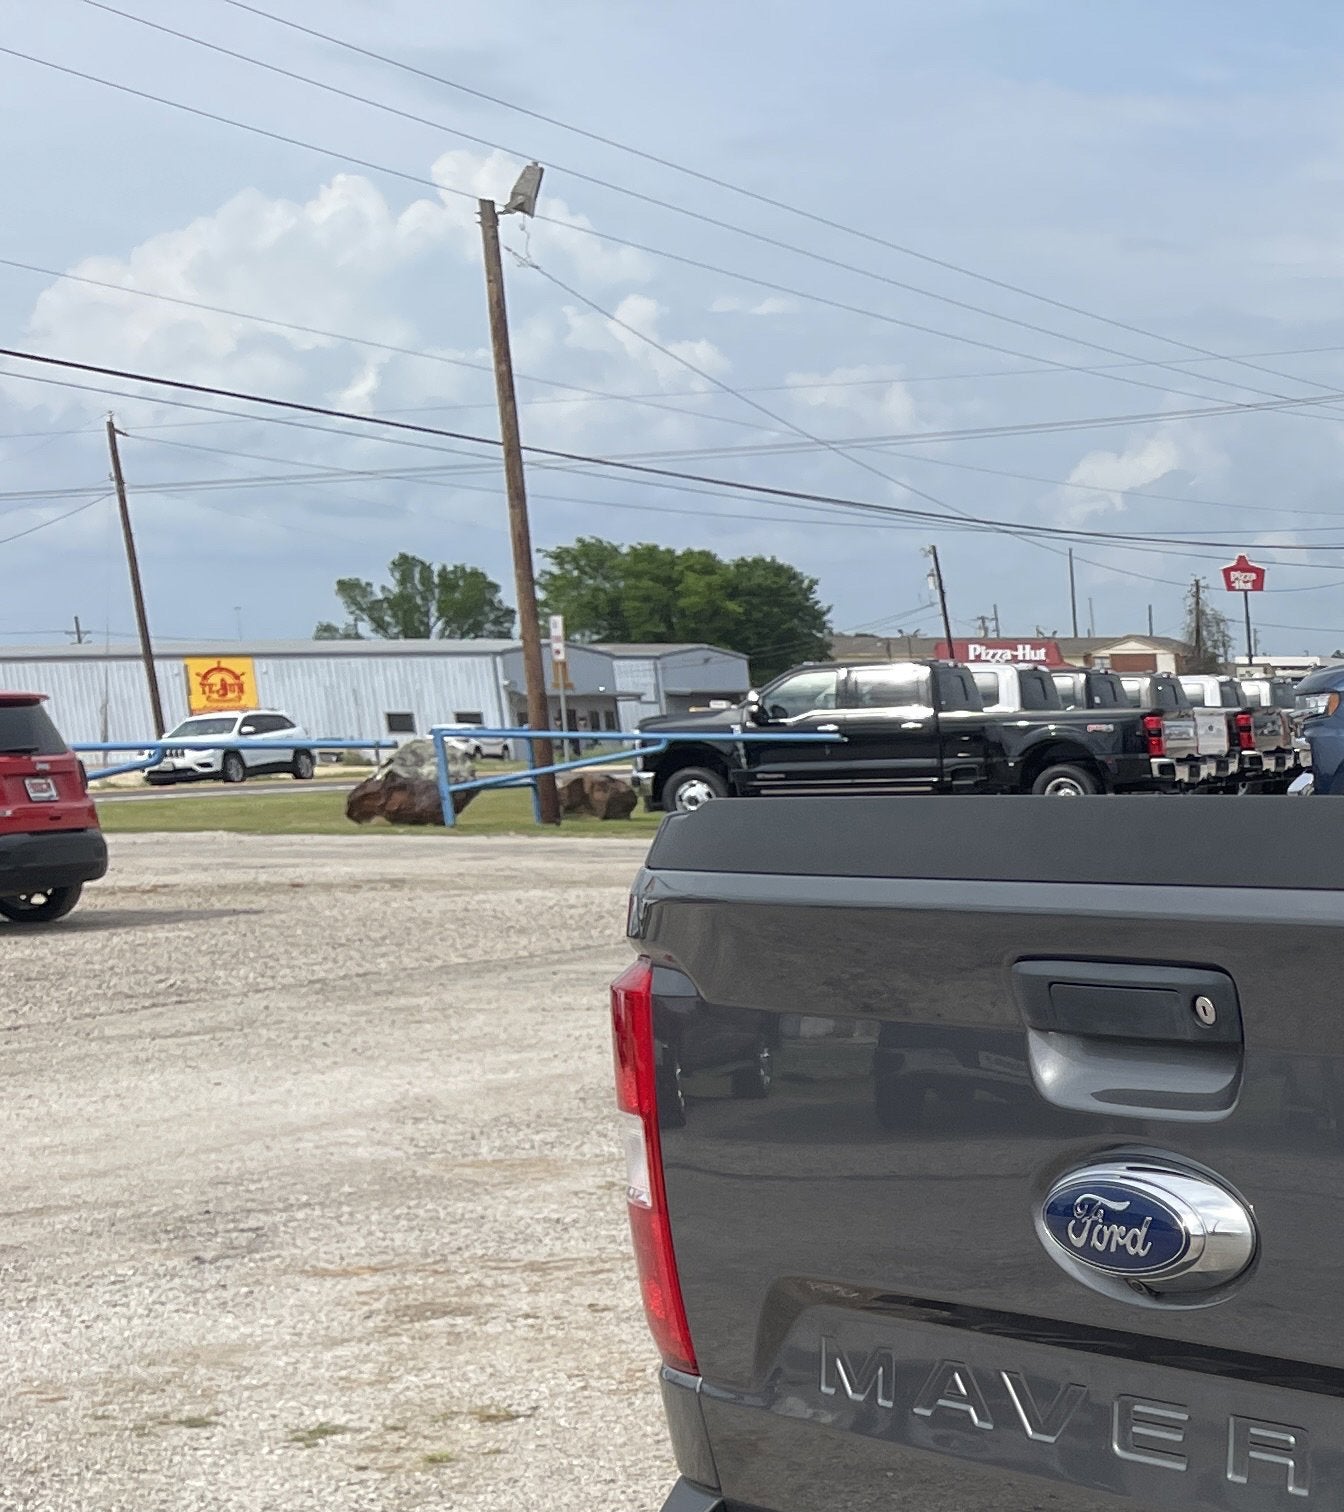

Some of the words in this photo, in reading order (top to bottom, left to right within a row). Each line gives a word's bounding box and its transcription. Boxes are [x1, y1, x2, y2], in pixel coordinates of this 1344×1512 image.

[968, 644, 1012, 663] Pizza
[1013, 644, 1047, 660] Hut
[1067, 1193, 1153, 1257] Ford
